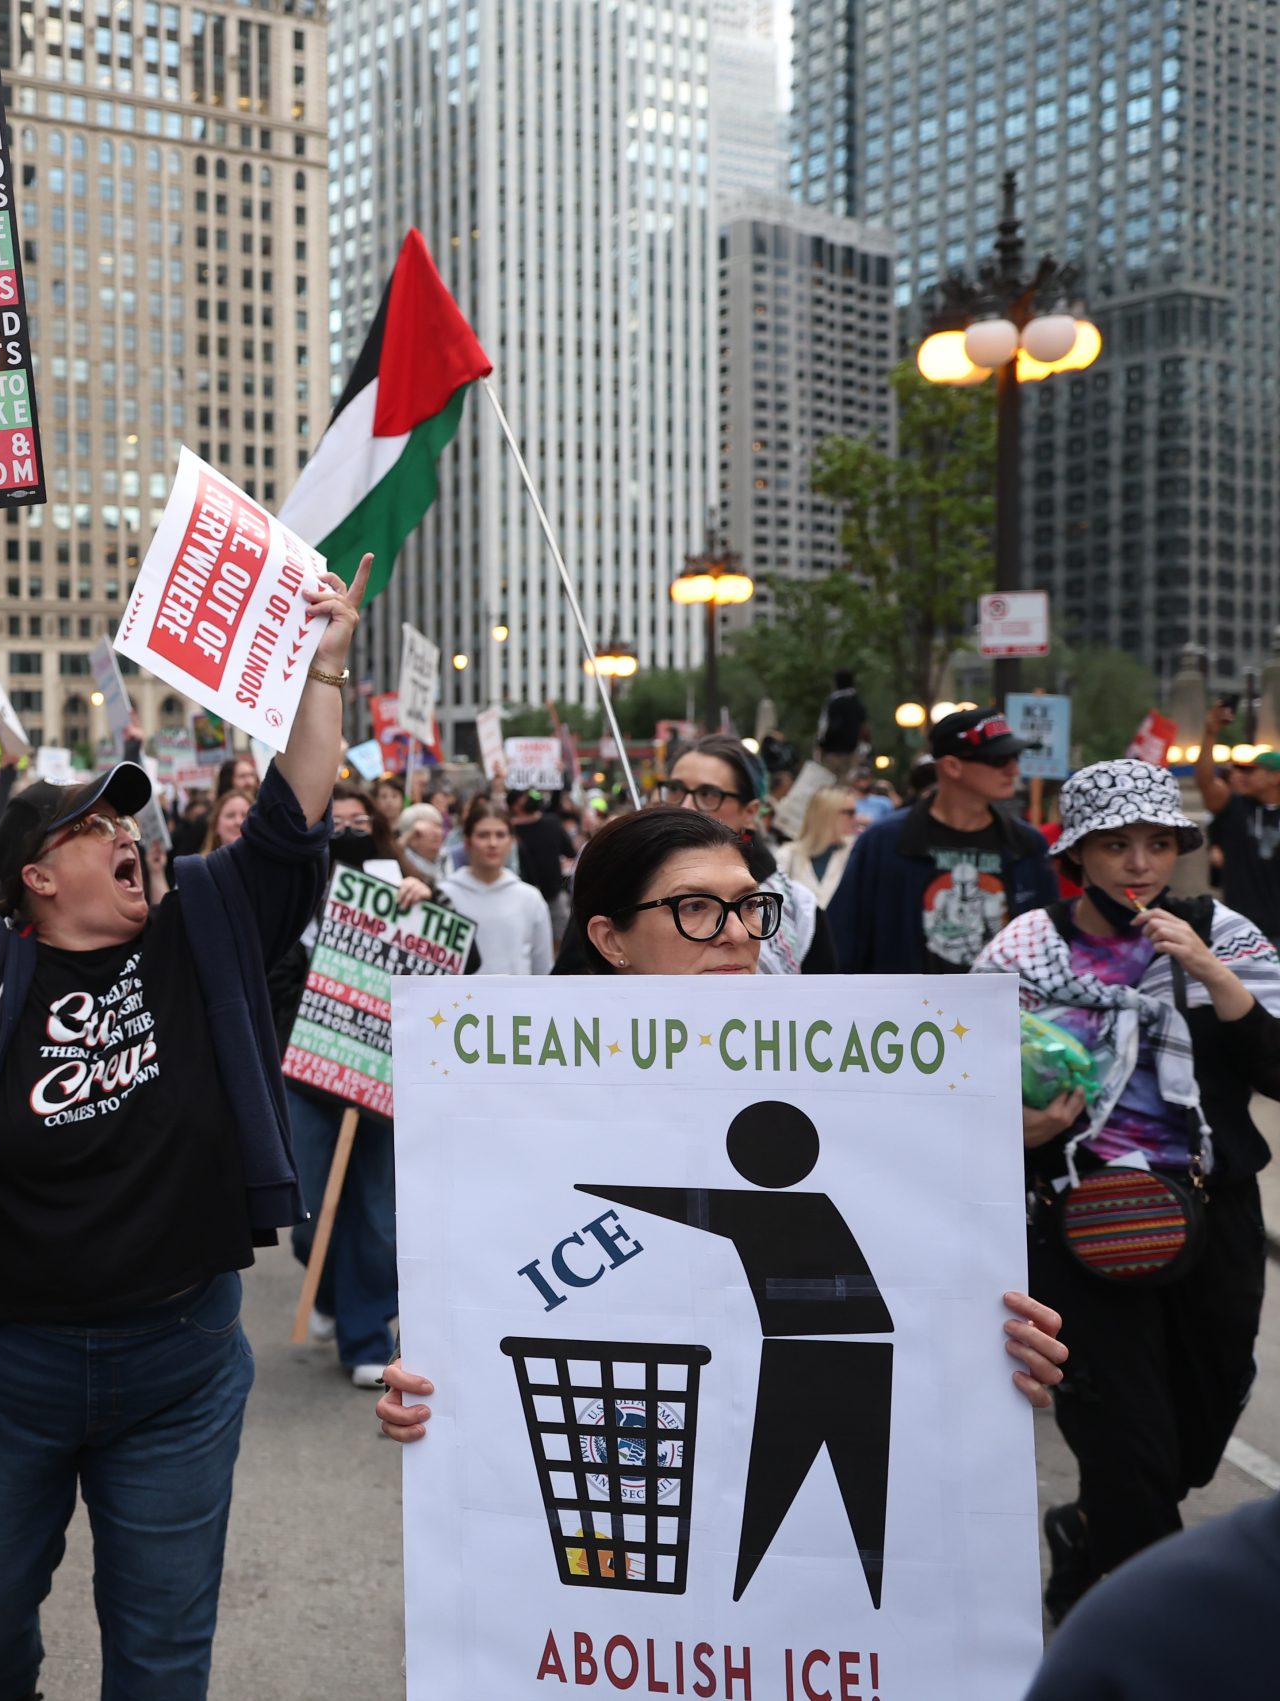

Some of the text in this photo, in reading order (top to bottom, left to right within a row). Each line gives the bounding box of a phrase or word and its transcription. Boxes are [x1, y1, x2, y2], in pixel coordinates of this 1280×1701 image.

[11, 432, 32, 457] &
[155, 483, 234, 646] EVERYWHERE
[277, 555, 305, 597] OUT
[204, 560, 252, 626] OUT
[263, 594, 291, 627] OF
[191, 618, 228, 665] OF
[235, 623, 279, 709] ILLINOIS
[335, 871, 471, 954] STOP THE
[318, 932, 405, 975] IMMIGRANT
[321, 920, 384, 954] DEFEND
[329, 900, 464, 973] TRUMP AGENDA!
[301, 989, 355, 1021] DEFEND
[306, 972, 346, 996] STOP
[124, 1011, 156, 1039] THE
[452, 1012, 603, 1069] CLEAN
[630, 1017, 688, 1071] UP
[718, 1019, 947, 1076] CHICAGO
[281, 1060, 359, 1100] ACADEMIC
[285, 1045, 341, 1077] DEFEND
[43, 1102, 97, 1128] COMES
[97, 1096, 121, 1116] TO
[516, 1208, 646, 1313] ICE
[536, 1628, 881, 1701] ABOLISH ICE!
